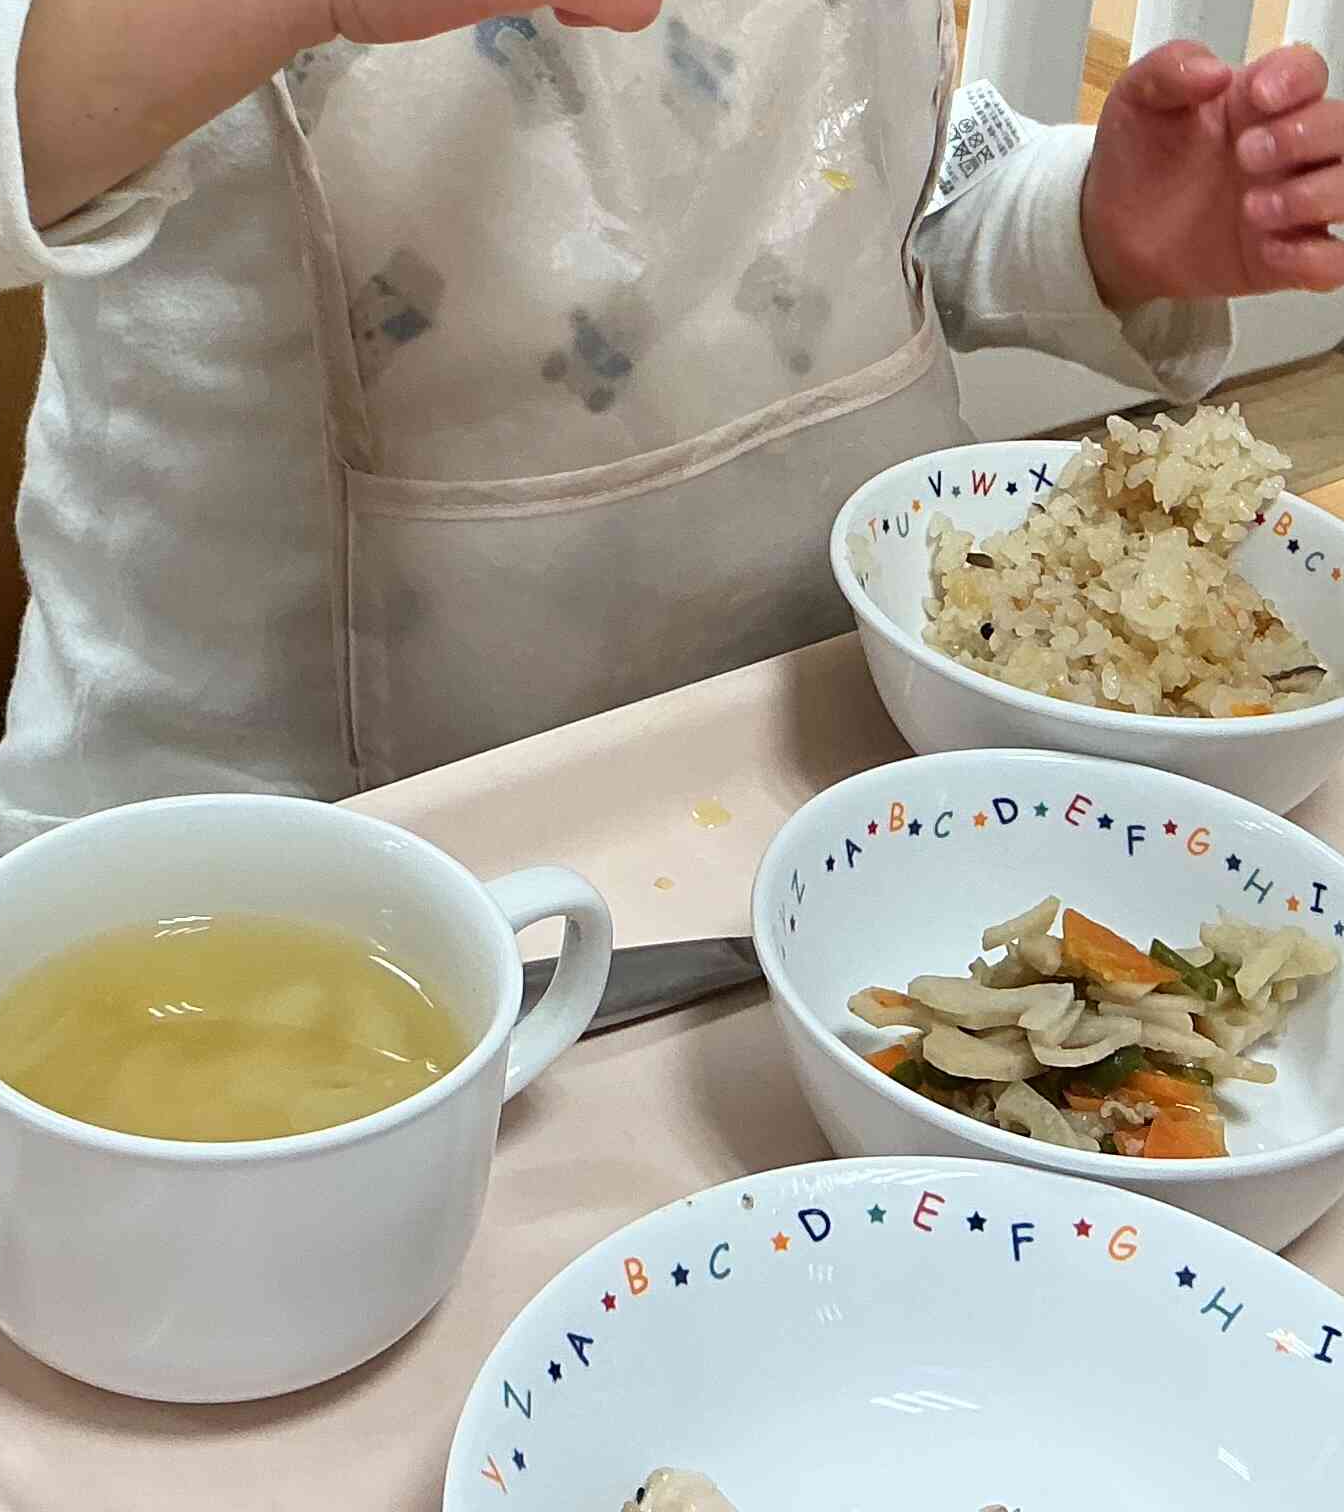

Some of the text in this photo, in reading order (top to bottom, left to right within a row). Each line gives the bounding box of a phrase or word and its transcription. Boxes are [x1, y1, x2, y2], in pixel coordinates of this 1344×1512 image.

[867, 517, 877, 543] T
[896, 511, 910, 538] U
[928, 470, 942, 497] V
[971, 470, 997, 496] W
[1029, 463, 1054, 492] X
[1273, 511, 1293, 536] B
[1305, 551, 1324, 572] C
[845, 838, 862, 868] A
[889, 802, 905, 832] B
[934, 811, 953, 838] C
[992, 797, 1018, 825] D
[1064, 794, 1092, 826] E
[1126, 824, 1145, 856] F
[1187, 827, 1211, 856] G
[1243, 868, 1274, 904] H
[1310, 881, 1328, 914] I
[481, 1455, 508, 1495] Y
[503, 1380, 532, 1419] Z
[566, 1332, 594, 1367] A
[623, 1257, 649, 1295] B
[709, 1242, 731, 1280] C
[798, 1208, 832, 1242] D
[913, 1191, 945, 1232] E
[1011, 1222, 1035, 1262] F
[1108, 1225, 1139, 1262] G
[1200, 1286, 1244, 1332] H
[1314, 1324, 1343, 1364] I
